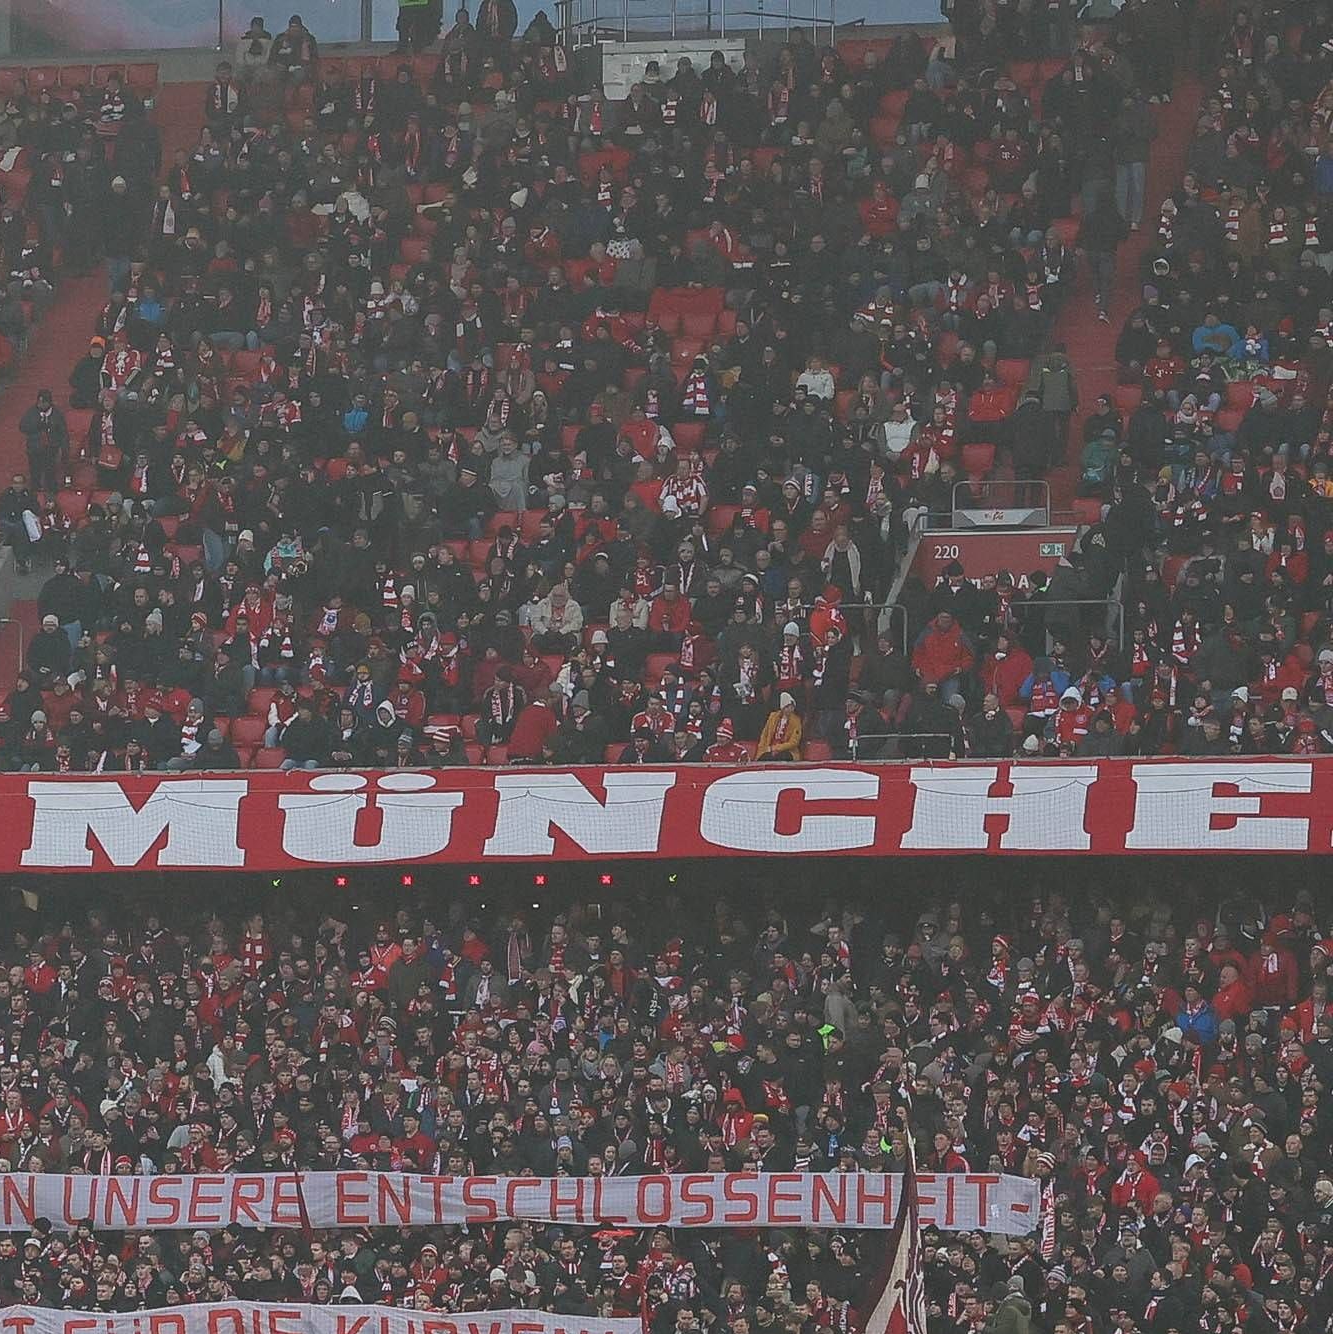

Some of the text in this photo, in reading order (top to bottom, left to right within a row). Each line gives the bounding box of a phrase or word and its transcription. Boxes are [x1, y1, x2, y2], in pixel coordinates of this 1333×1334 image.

[934, 545, 959, 559] 220
[21, 762, 1333, 867] MÜNCHE
[61, 1174, 306, 1226] UNSERE
